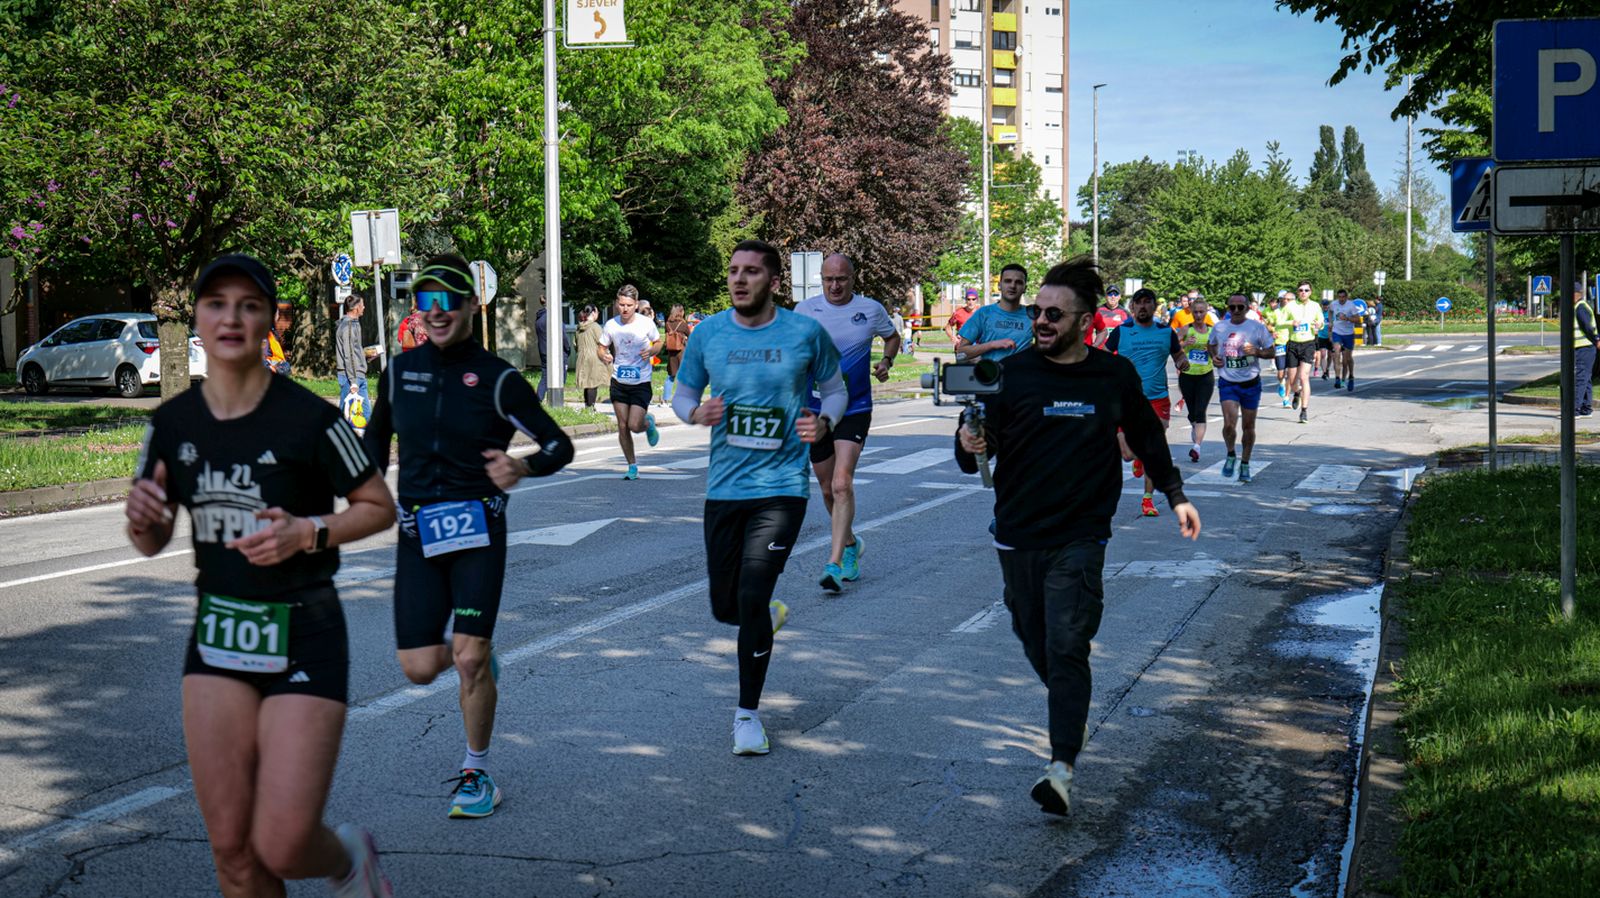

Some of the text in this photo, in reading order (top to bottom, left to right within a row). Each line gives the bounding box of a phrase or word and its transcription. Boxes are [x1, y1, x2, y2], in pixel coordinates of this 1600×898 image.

[1538, 48, 1597, 133] P
[620, 370, 637, 378] 238
[729, 415, 781, 437] 1137
[429, 512, 475, 539] 192
[202, 613, 279, 654] 1101
